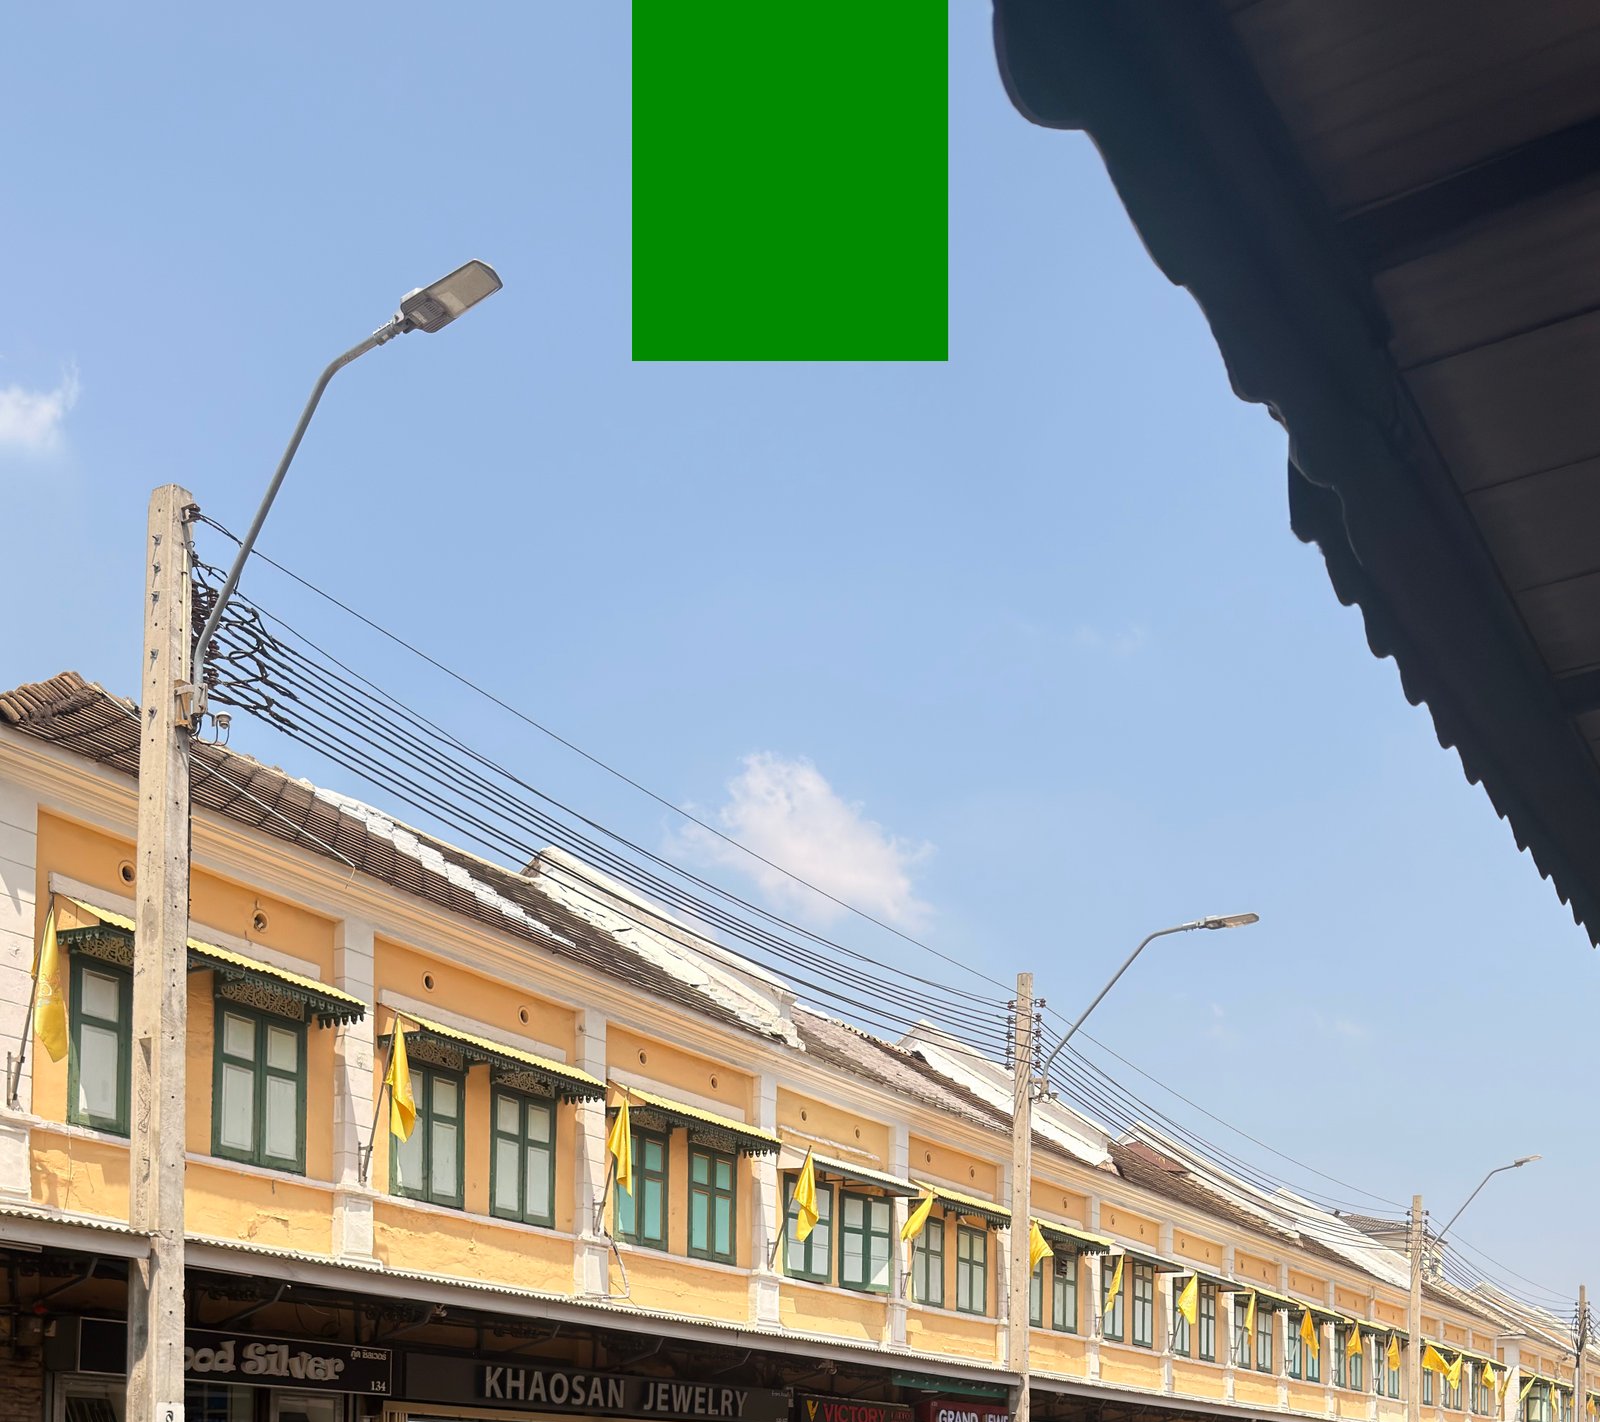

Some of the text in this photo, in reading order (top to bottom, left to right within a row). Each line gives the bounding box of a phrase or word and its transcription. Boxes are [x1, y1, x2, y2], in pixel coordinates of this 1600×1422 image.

[241, 1343, 345, 1381] Silver
[371, 1381, 386, 1391] 134
[484, 1366, 749, 1417] KHAOSAN JEWELRY
